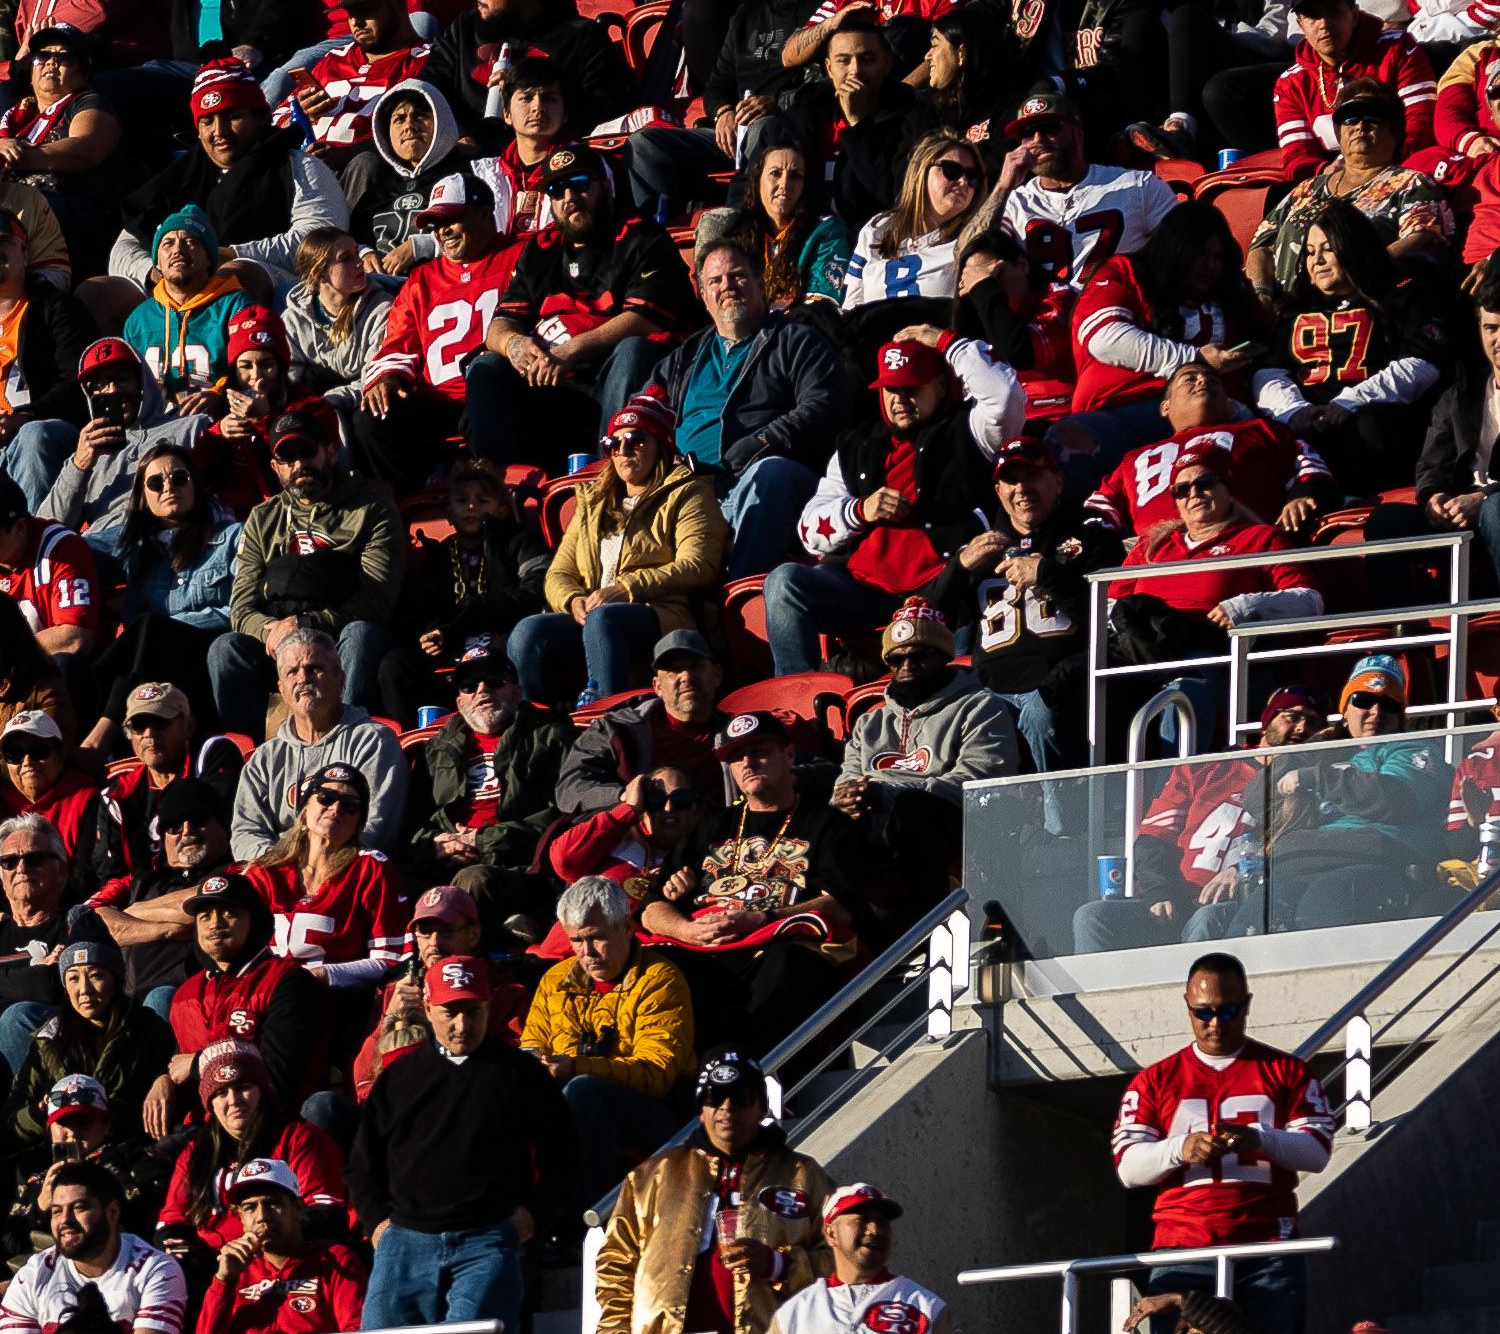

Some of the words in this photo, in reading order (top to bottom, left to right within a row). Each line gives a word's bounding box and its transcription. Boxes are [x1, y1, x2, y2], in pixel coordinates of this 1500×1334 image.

[884, 254, 924, 299] 8
[426, 289, 499, 386] 21
[1292, 310, 1375, 385] 97
[57, 577, 90, 609] 12
[1171, 1092, 1275, 1187] 42
